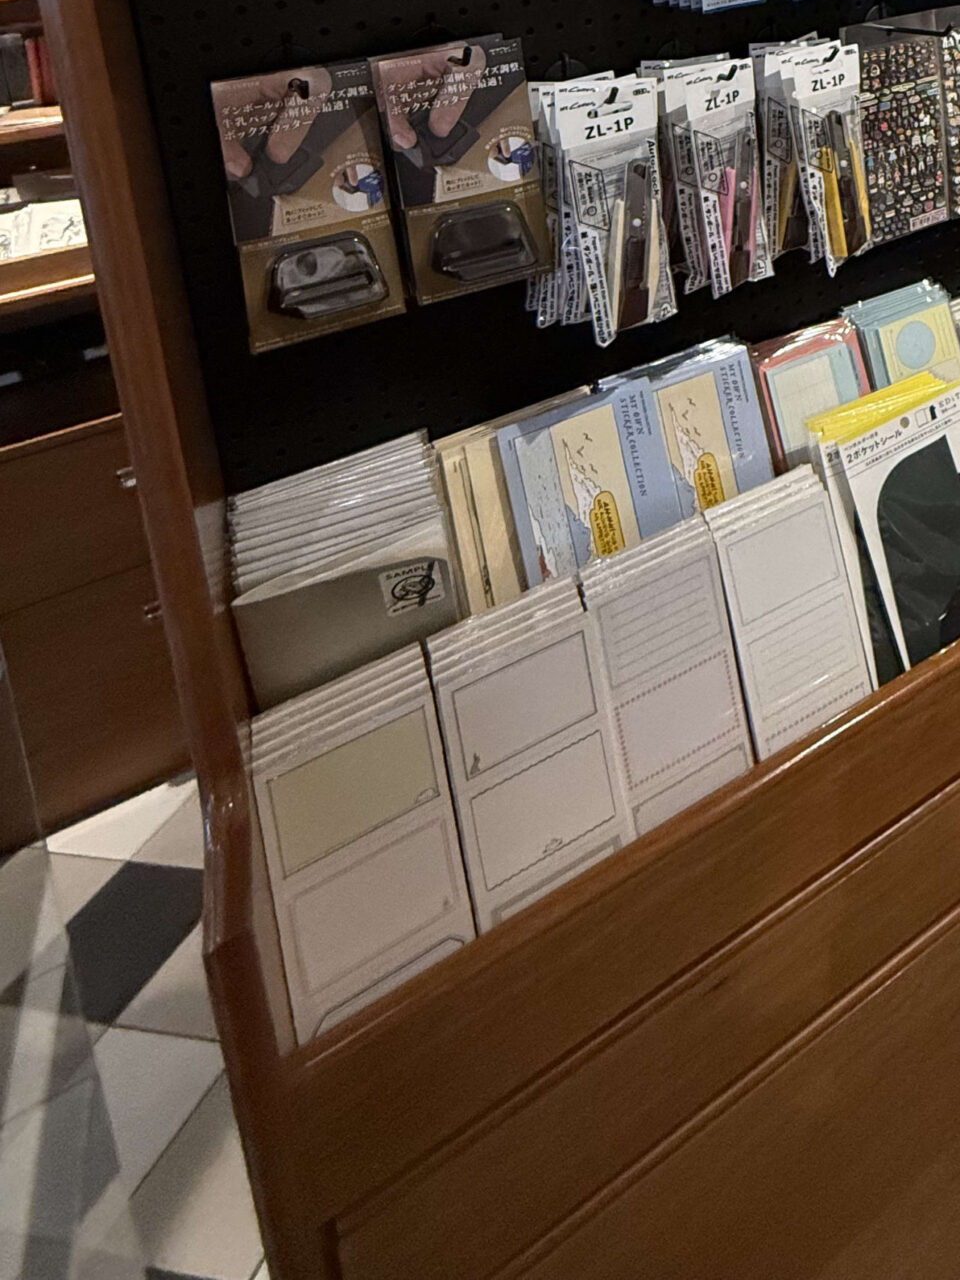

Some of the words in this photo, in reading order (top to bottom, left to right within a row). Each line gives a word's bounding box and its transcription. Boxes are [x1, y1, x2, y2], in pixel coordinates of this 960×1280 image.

[811, 73, 846, 92] ZL-1P
[391, 95, 470, 116] ボックスカッター
[705, 89, 740, 112] ZL-1P
[224, 120, 313, 141] ボックスカッター
[584, 116, 635, 140] ZL-1P
[721, 366, 734, 406] STICKER
[728, 405, 745, 459] COLLECTION
[619, 397, 634, 441] STICKER
[628, 438, 648, 497] COLLECTION
[846, 429, 903, 464] 2ポケットシール
[385, 565, 428, 581] SAMPL
